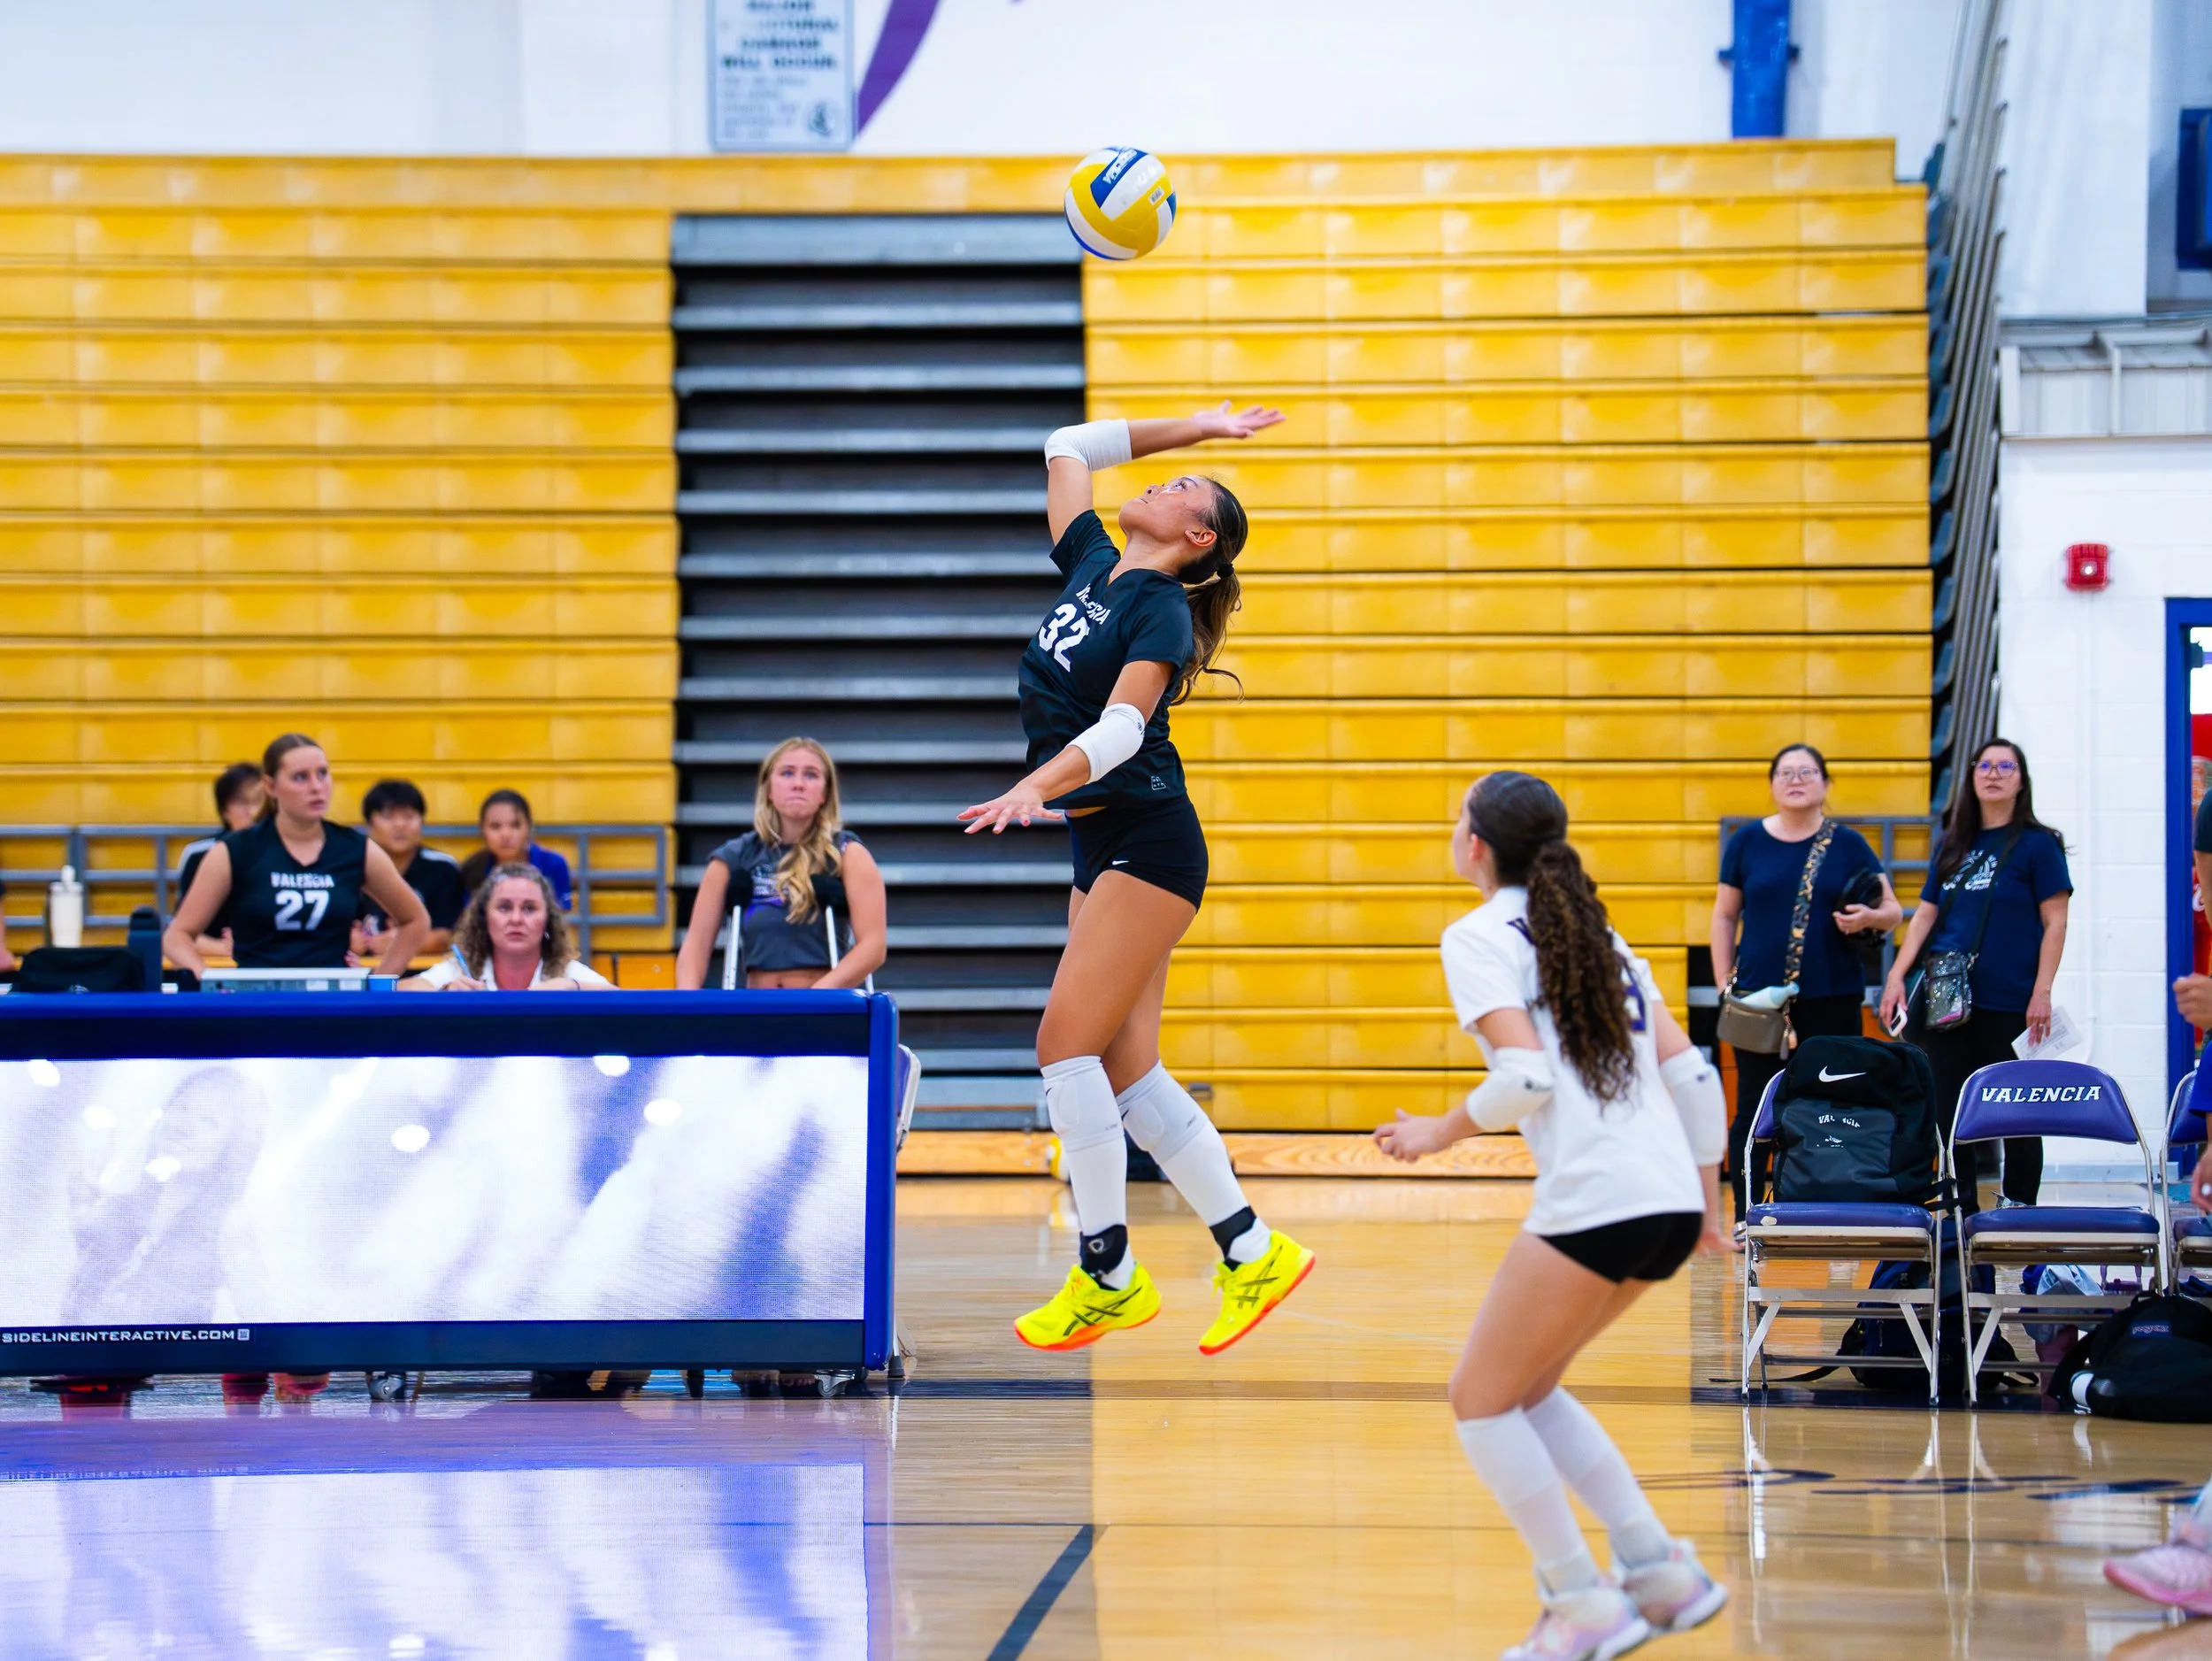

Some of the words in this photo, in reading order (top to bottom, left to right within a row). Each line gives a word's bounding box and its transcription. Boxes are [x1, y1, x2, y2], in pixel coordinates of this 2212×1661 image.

[1039, 604, 1090, 673] 32
[270, 872, 334, 888] VALENCIA
[274, 889, 329, 931] 27
[1981, 1086, 2101, 1103] VALENCIA
[1818, 1114, 1861, 1128] VALCIA
[2, 1329, 235, 1344] SIDELINEINTERACTIVE.COM
